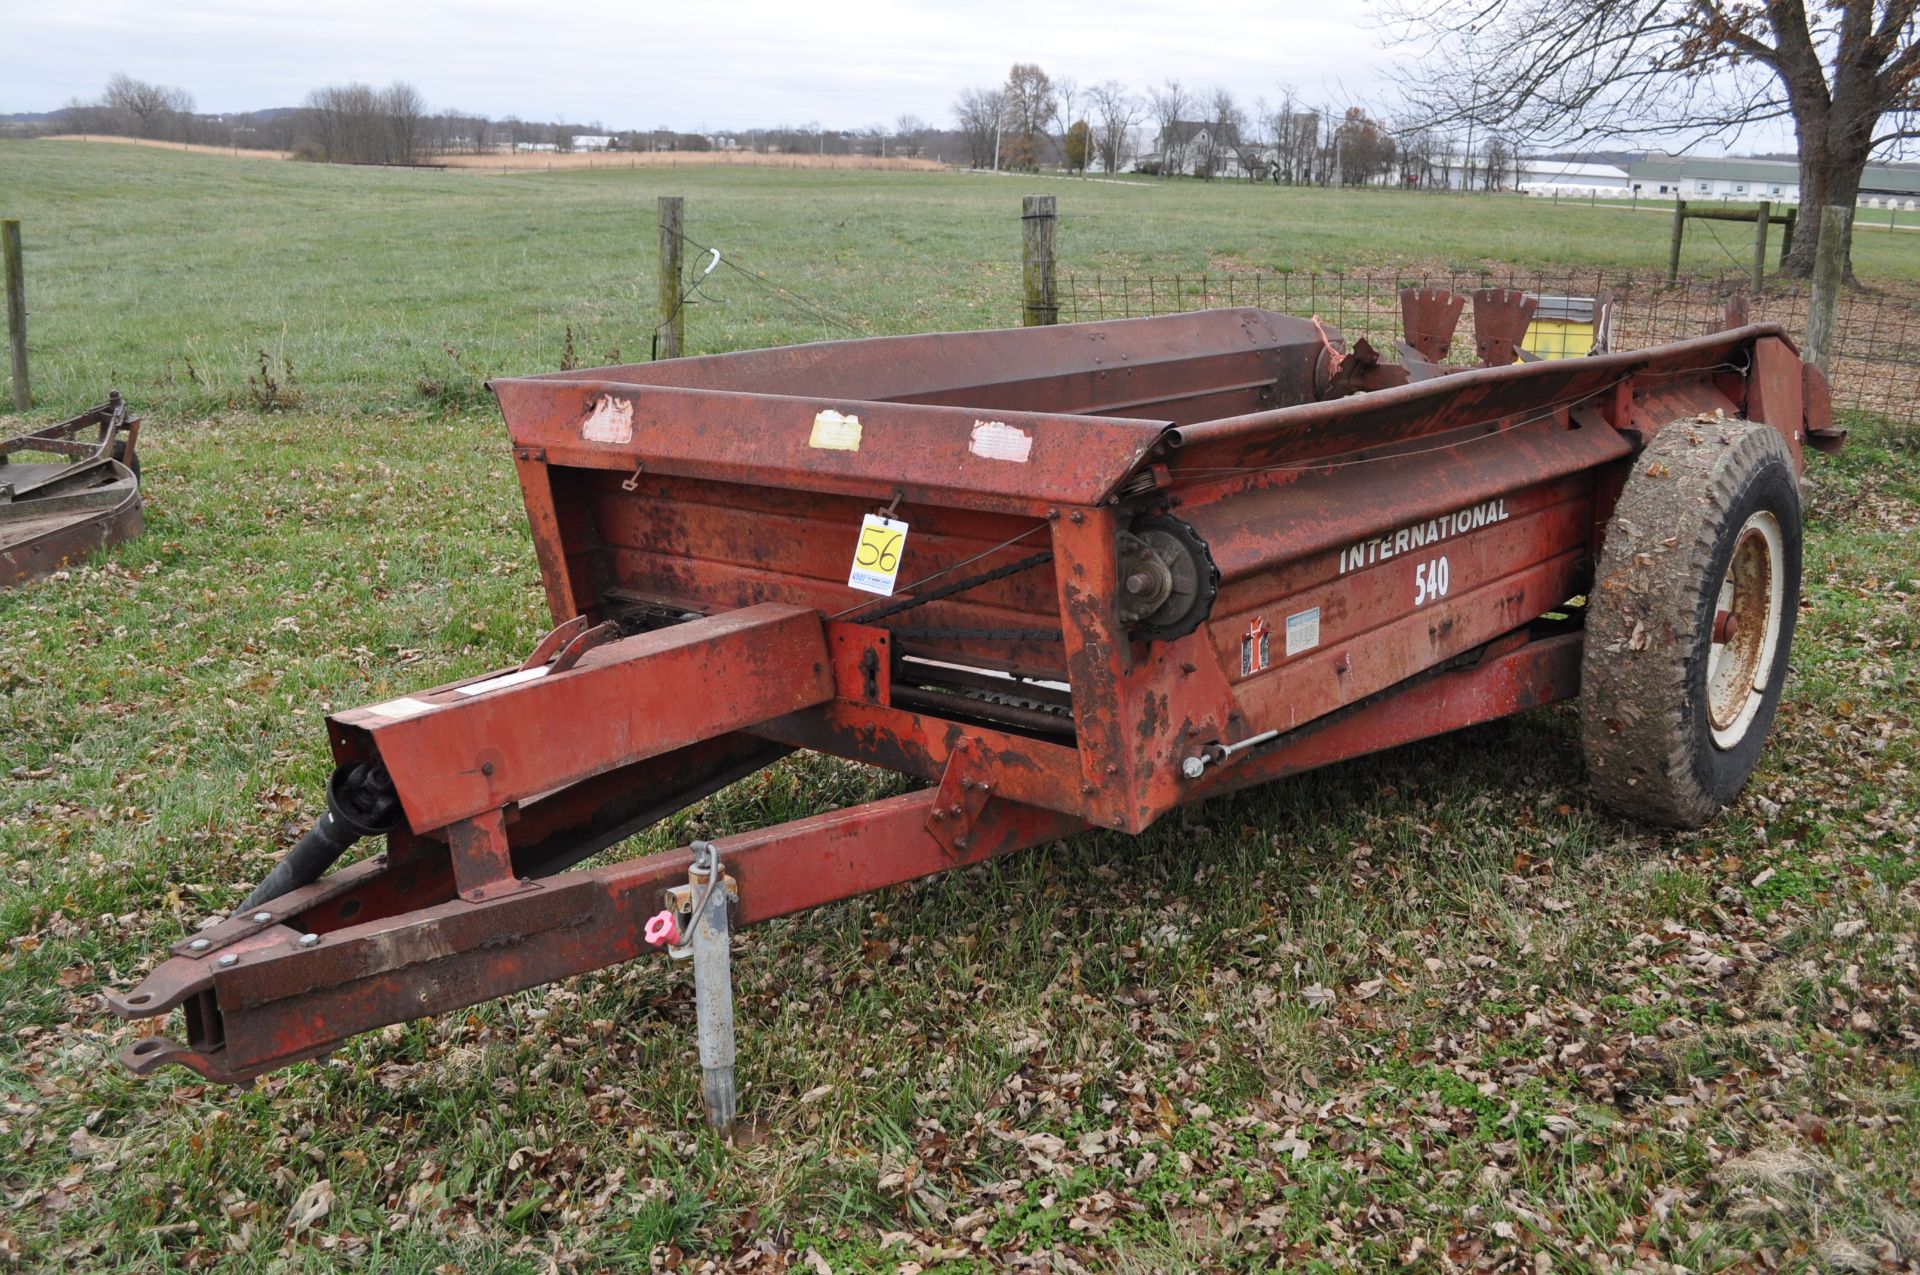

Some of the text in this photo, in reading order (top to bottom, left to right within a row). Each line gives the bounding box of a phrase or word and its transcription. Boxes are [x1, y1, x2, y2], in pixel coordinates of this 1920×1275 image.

[856, 527, 902, 572] 56
[1339, 499, 1509, 574] INTERNATIONAL
[1414, 556, 1449, 606] 540
